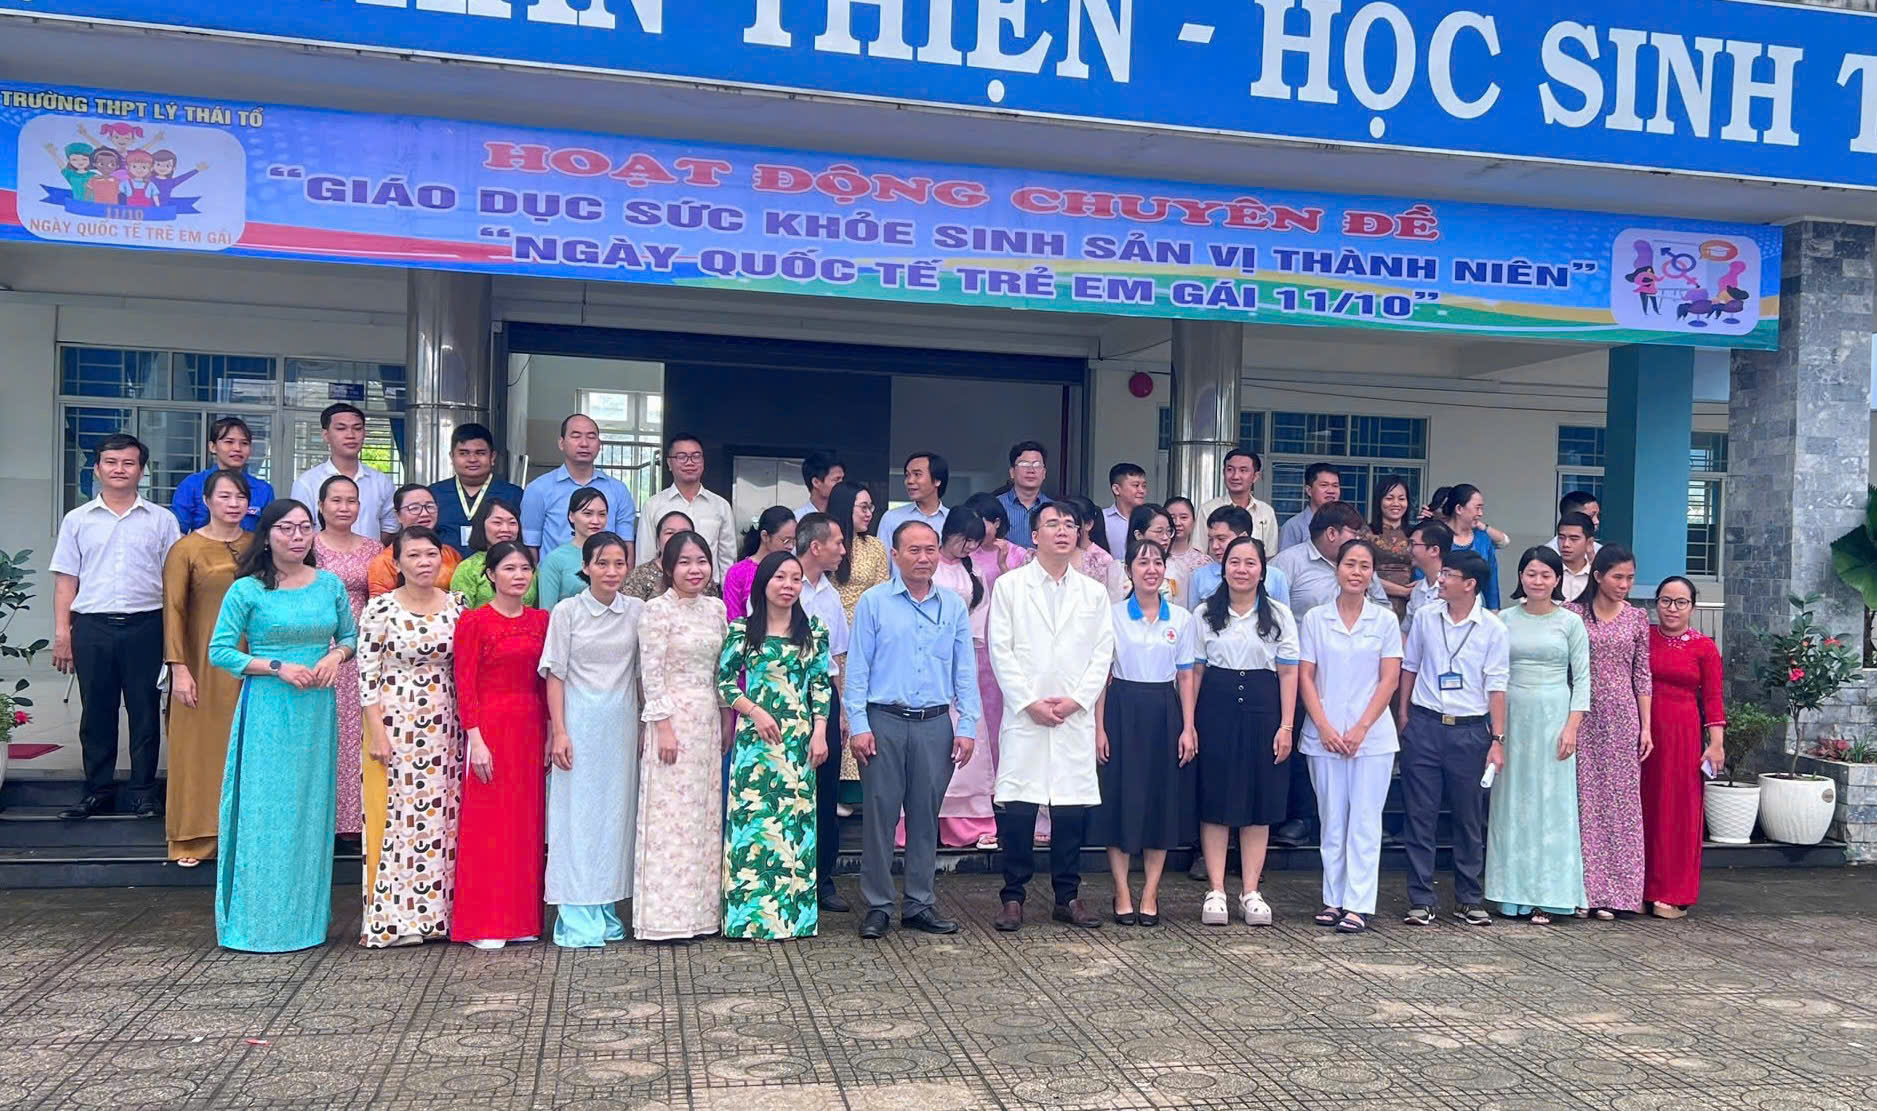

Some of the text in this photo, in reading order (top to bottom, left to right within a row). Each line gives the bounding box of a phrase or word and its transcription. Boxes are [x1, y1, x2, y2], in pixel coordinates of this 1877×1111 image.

[1, 90, 263, 128] TRƯỜNG THPT LÝ THÁI TỔ
[1250, 0, 1501, 139] HỌC
[1538, 21, 1803, 146] SINH
[30, 216, 71, 233] NGÀY
[77, 219, 118, 237] QUỐC
[179, 229, 201, 243] EM
[269, 166, 1597, 288] “GIÁO DỤC SỨC KHỎE SINH SẢN VỊ THÀNH NIÊN”
[485, 142, 1439, 241] HOẠT ĐỘNG CHUYÊN ĐỀ
[479, 226, 1439, 317] “NGÀY QUỐC TẾ TRẺ EM GÁI 11/10”
